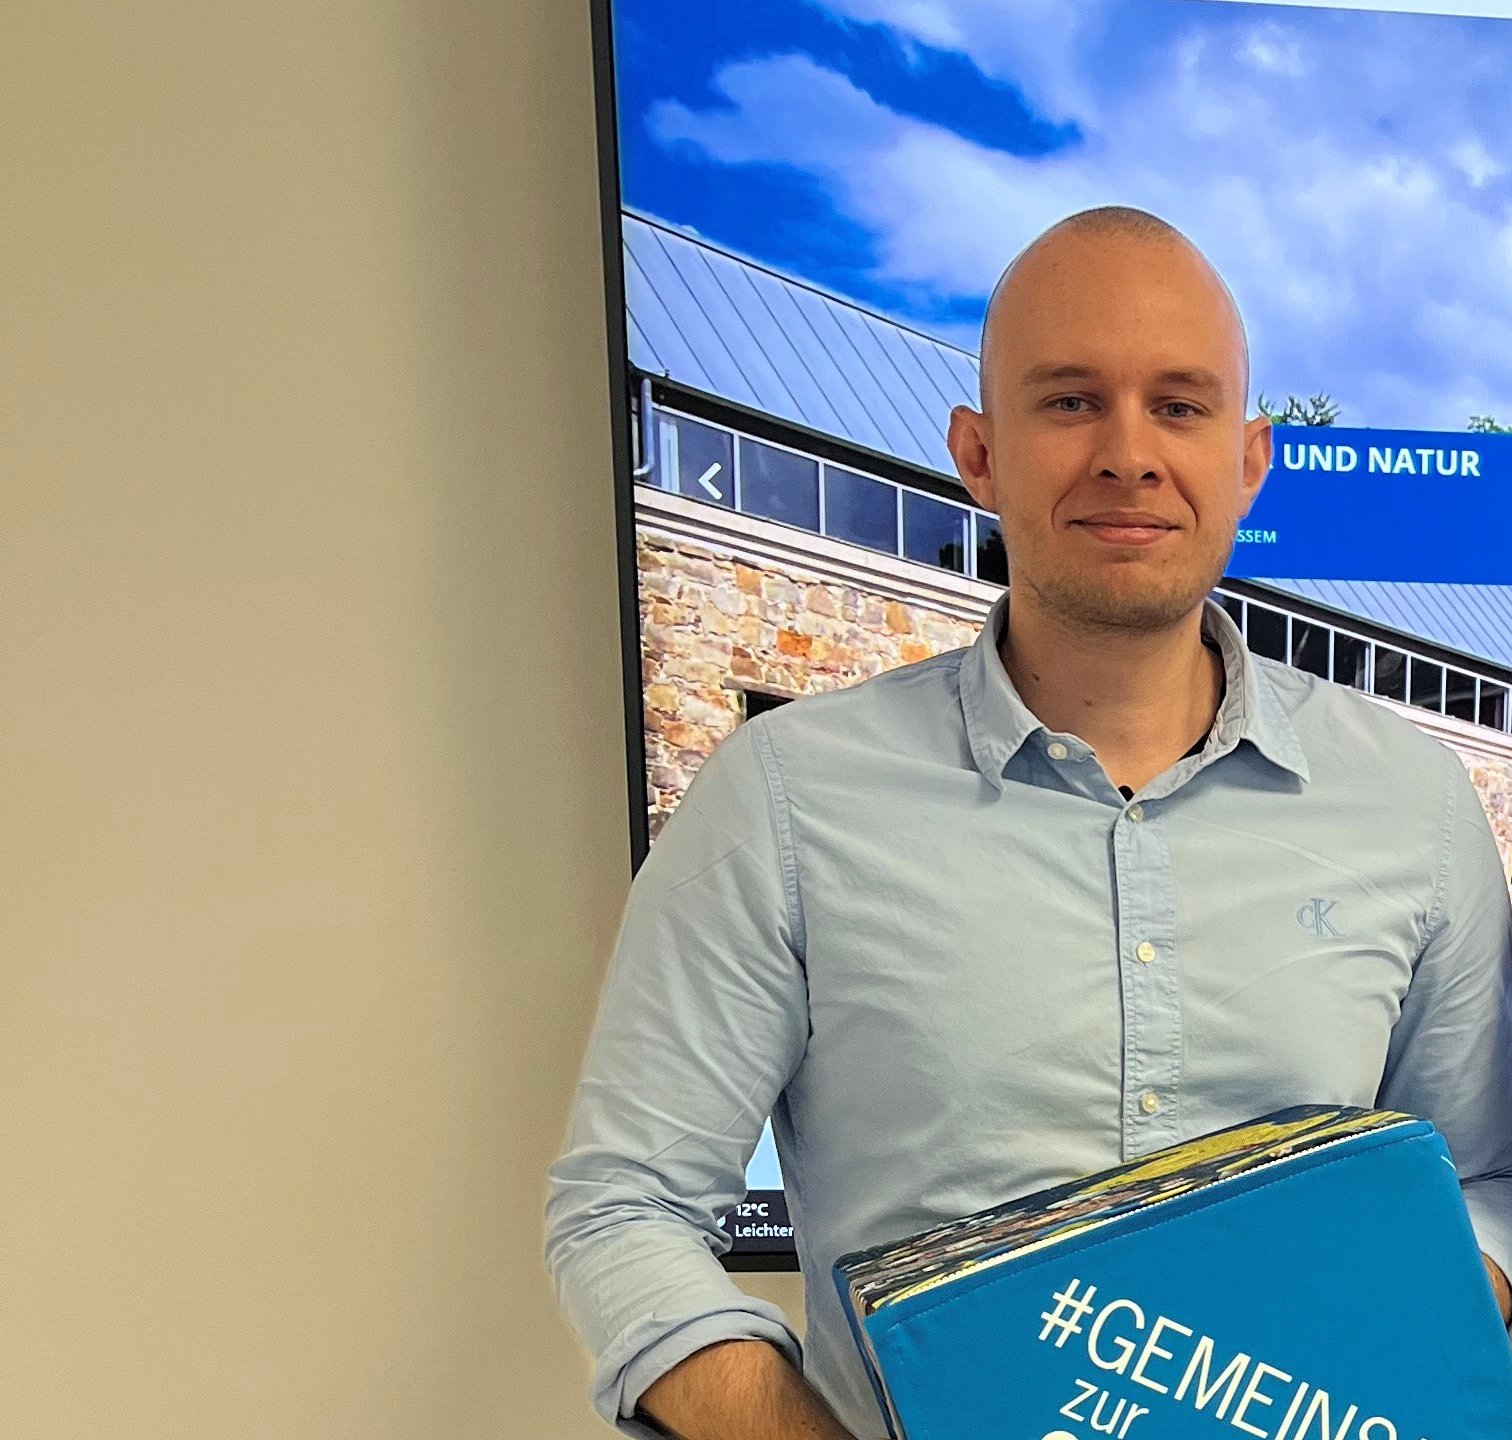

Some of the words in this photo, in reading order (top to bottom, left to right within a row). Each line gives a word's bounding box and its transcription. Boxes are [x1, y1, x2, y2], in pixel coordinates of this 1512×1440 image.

[1283, 443, 1358, 472] UND
[1368, 447, 1481, 477] NATUR
[1236, 530, 1277, 543] SSEM
[736, 1203, 769, 1217] 12°C
[735, 1223, 794, 1237] Leichter
[1038, 1278, 1427, 1440] #GEMEIN
[1059, 1378, 1150, 1440] zur
